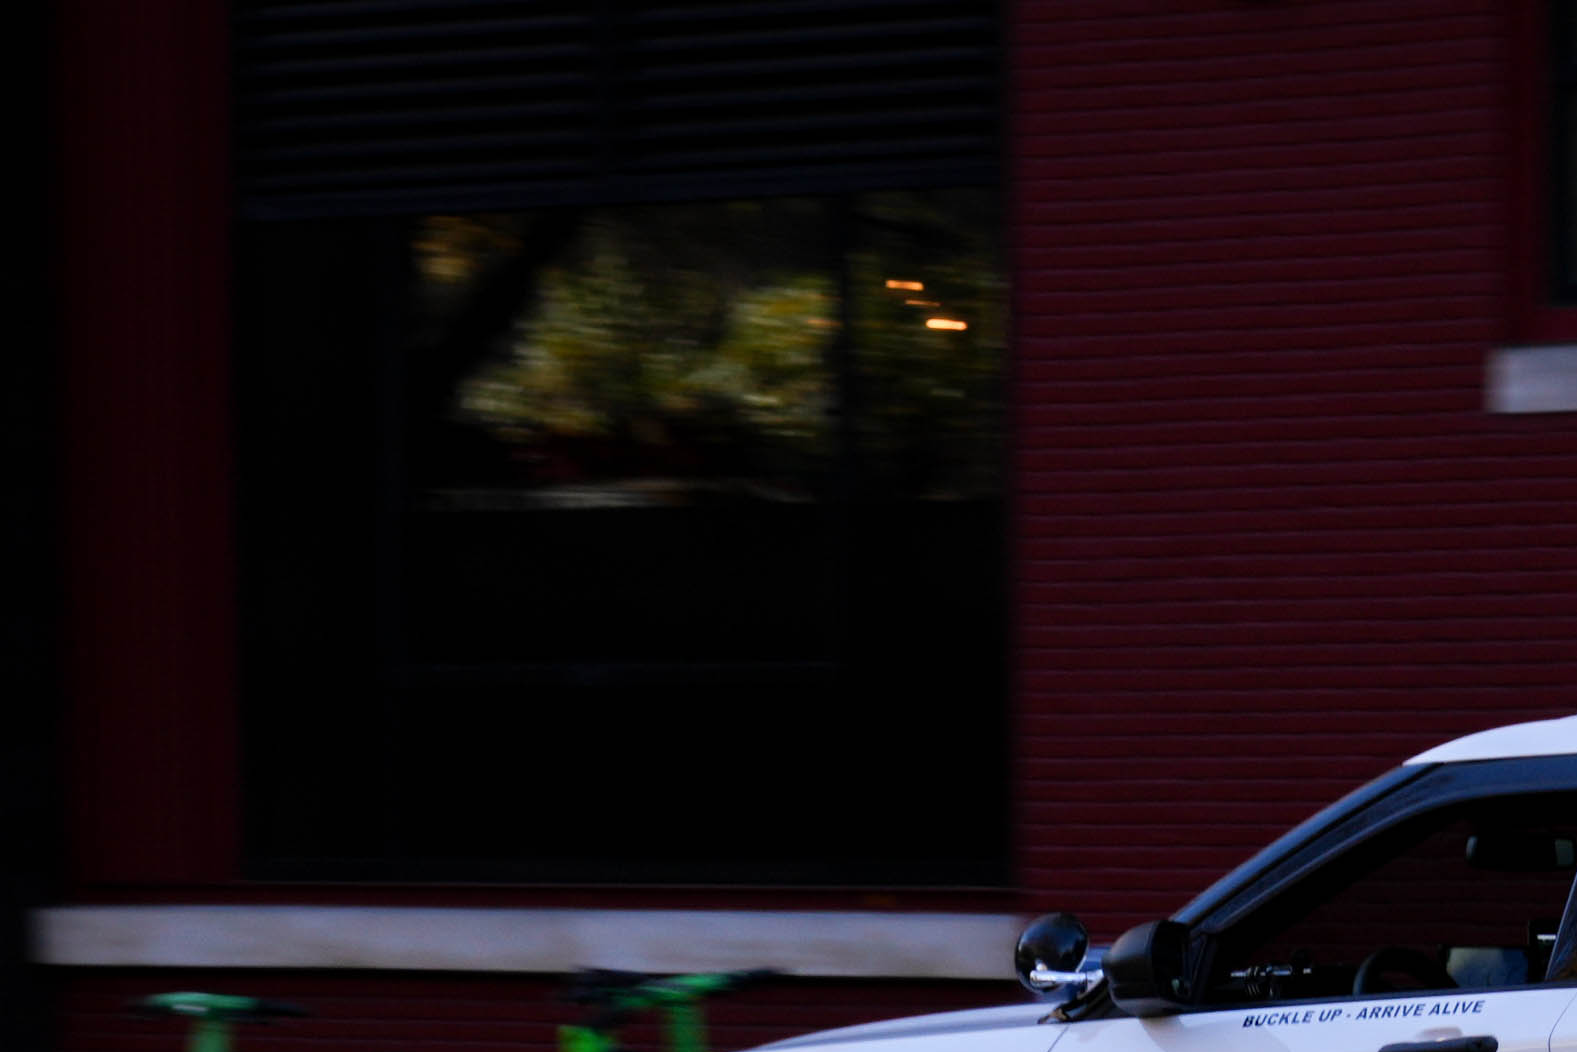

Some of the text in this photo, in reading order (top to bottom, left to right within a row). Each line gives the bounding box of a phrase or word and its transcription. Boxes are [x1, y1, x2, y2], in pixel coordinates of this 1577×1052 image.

[1242, 1010, 1315, 1028] BUCKLE
[1318, 1008, 1342, 1023] UP
[1355, 1003, 1426, 1020] ARRIVE
[1428, 1000, 1486, 1016] ALIVE
